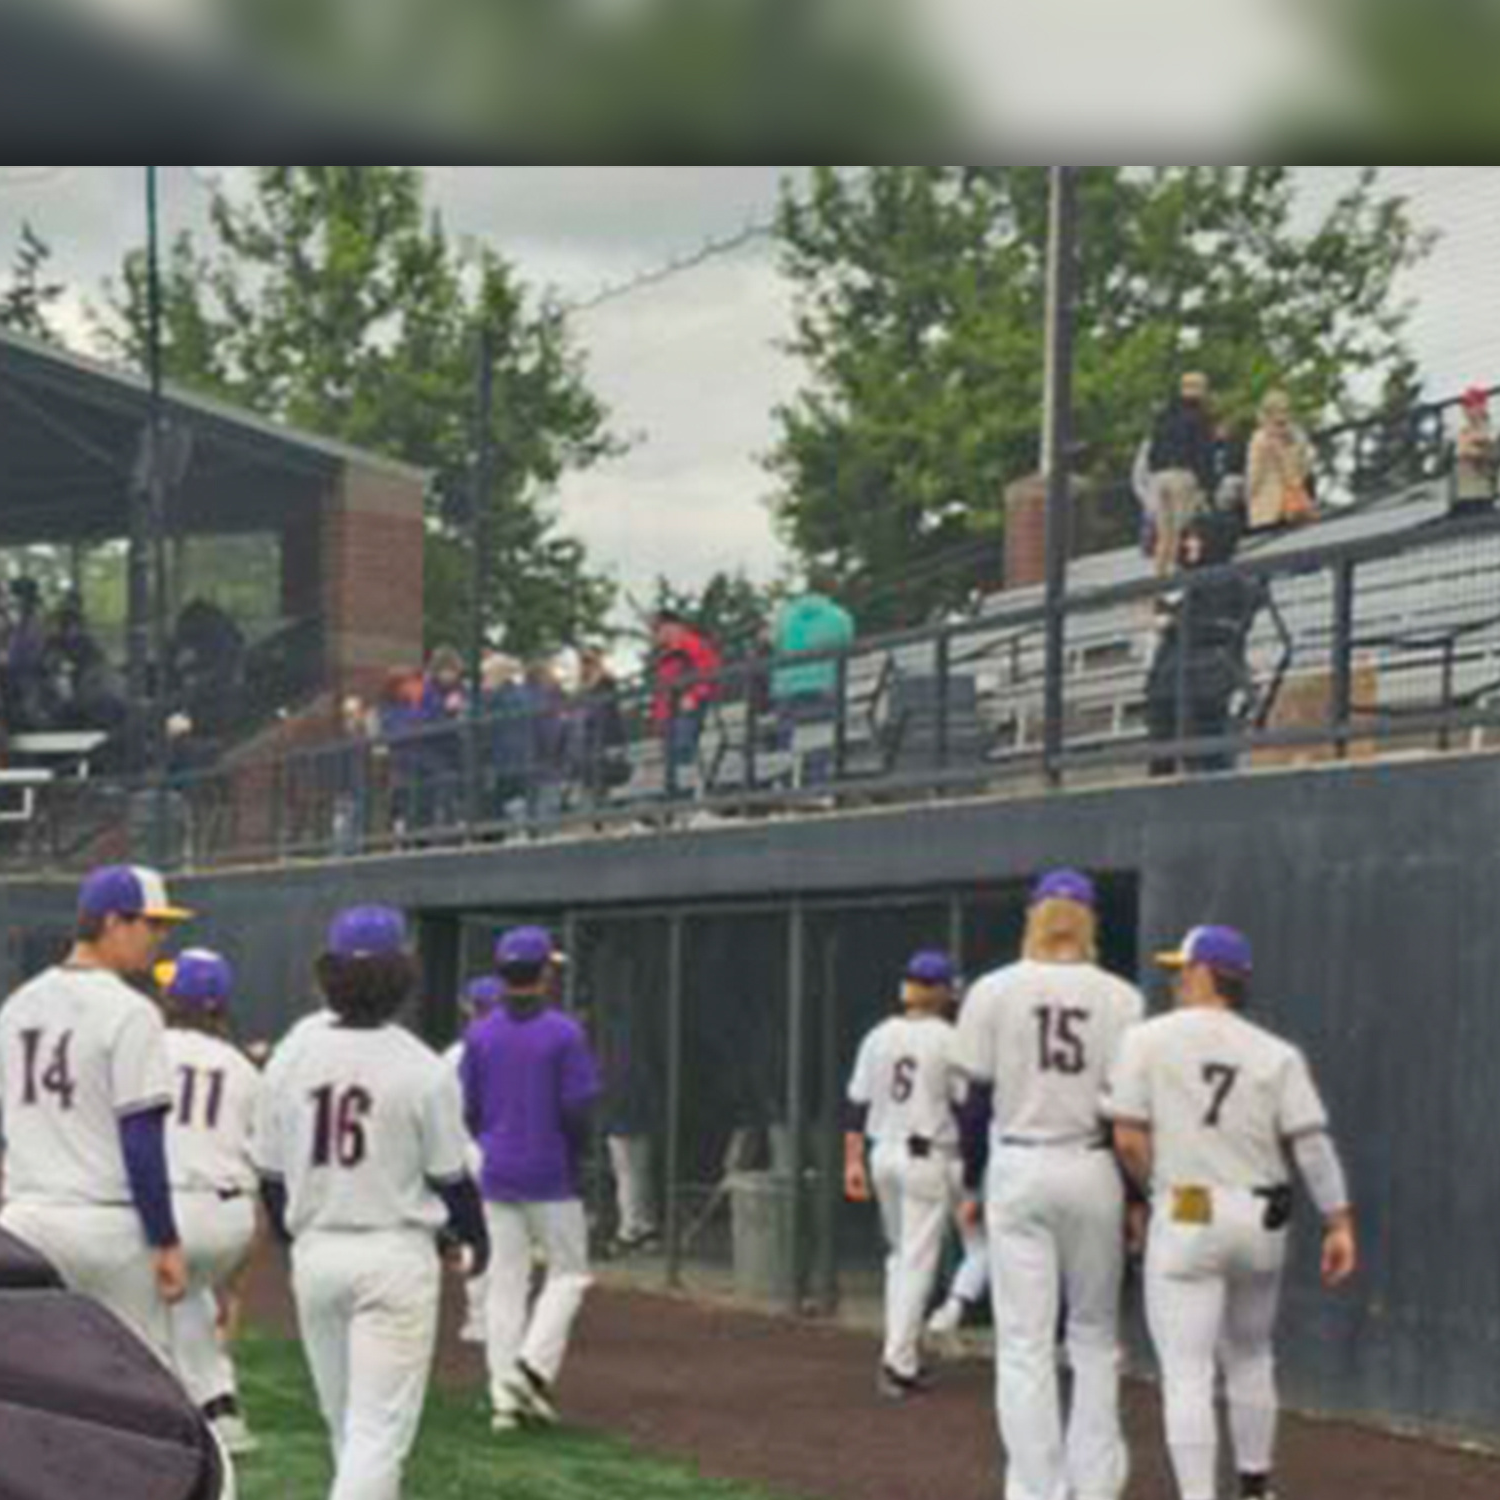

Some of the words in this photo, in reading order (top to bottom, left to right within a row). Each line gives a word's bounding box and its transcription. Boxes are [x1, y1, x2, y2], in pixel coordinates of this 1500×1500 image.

[20, 1028, 75, 1110] 14
[1034, 1005, 1088, 1074] 15
[178, 1064, 225, 1128] 11
[892, 1056, 916, 1104] 6
[1202, 1062, 1238, 1126] 7
[309, 1083, 372, 1169] 16
